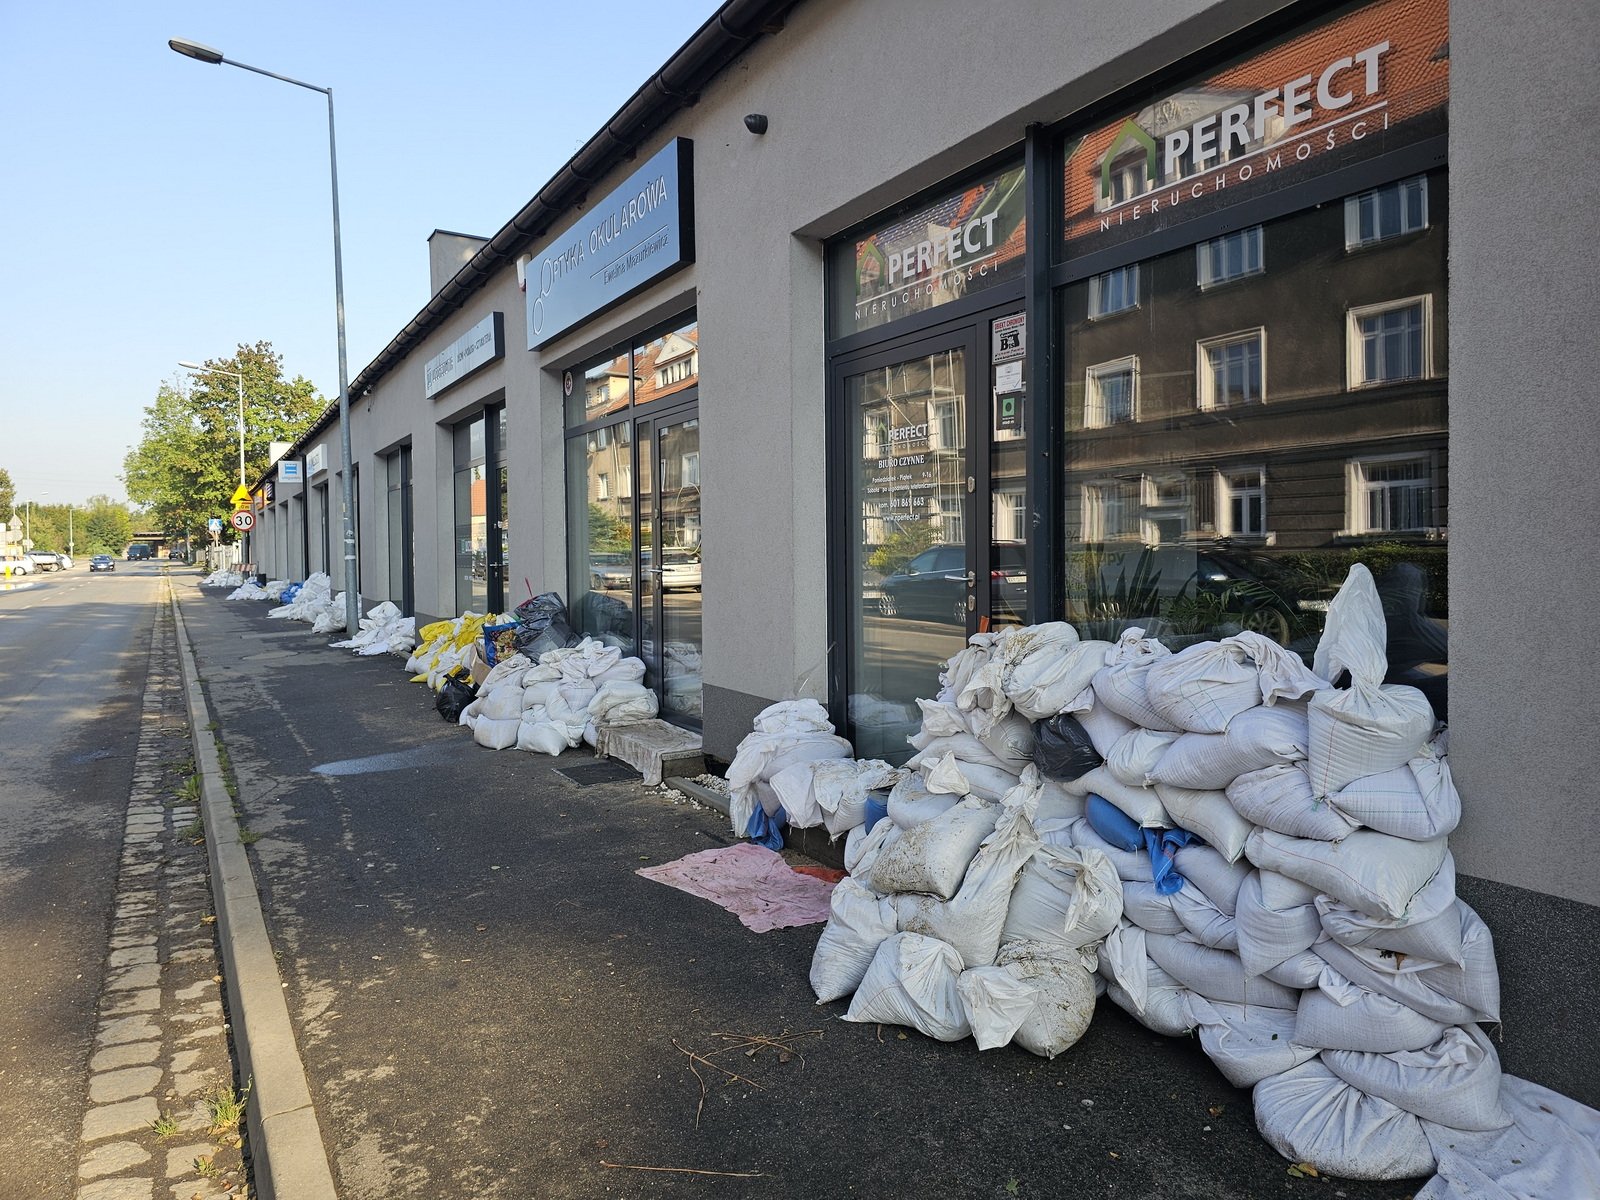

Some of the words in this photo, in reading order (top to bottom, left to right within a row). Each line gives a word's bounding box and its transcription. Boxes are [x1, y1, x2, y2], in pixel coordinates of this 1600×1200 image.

[1164, 40, 1390, 176] PERFECT
[1100, 112, 1389, 233] NIERUCHOMOŚCI
[540, 239, 584, 298] OPTYKA
[603, 263, 626, 286] Ewelina
[626, 233, 669, 272] Mazurkiewicz
[888, 210, 998, 284] PERFECT
[855, 260, 998, 321] NIERUCHOMOŚCI
[888, 424, 928, 442] PERFECT
[878, 457, 897, 469] BIURO
[899, 454, 925, 467] CZYNNE
[235, 515, 252, 526] 30
[890, 498, 900, 508] 601
[913, 497, 925, 507] 663
